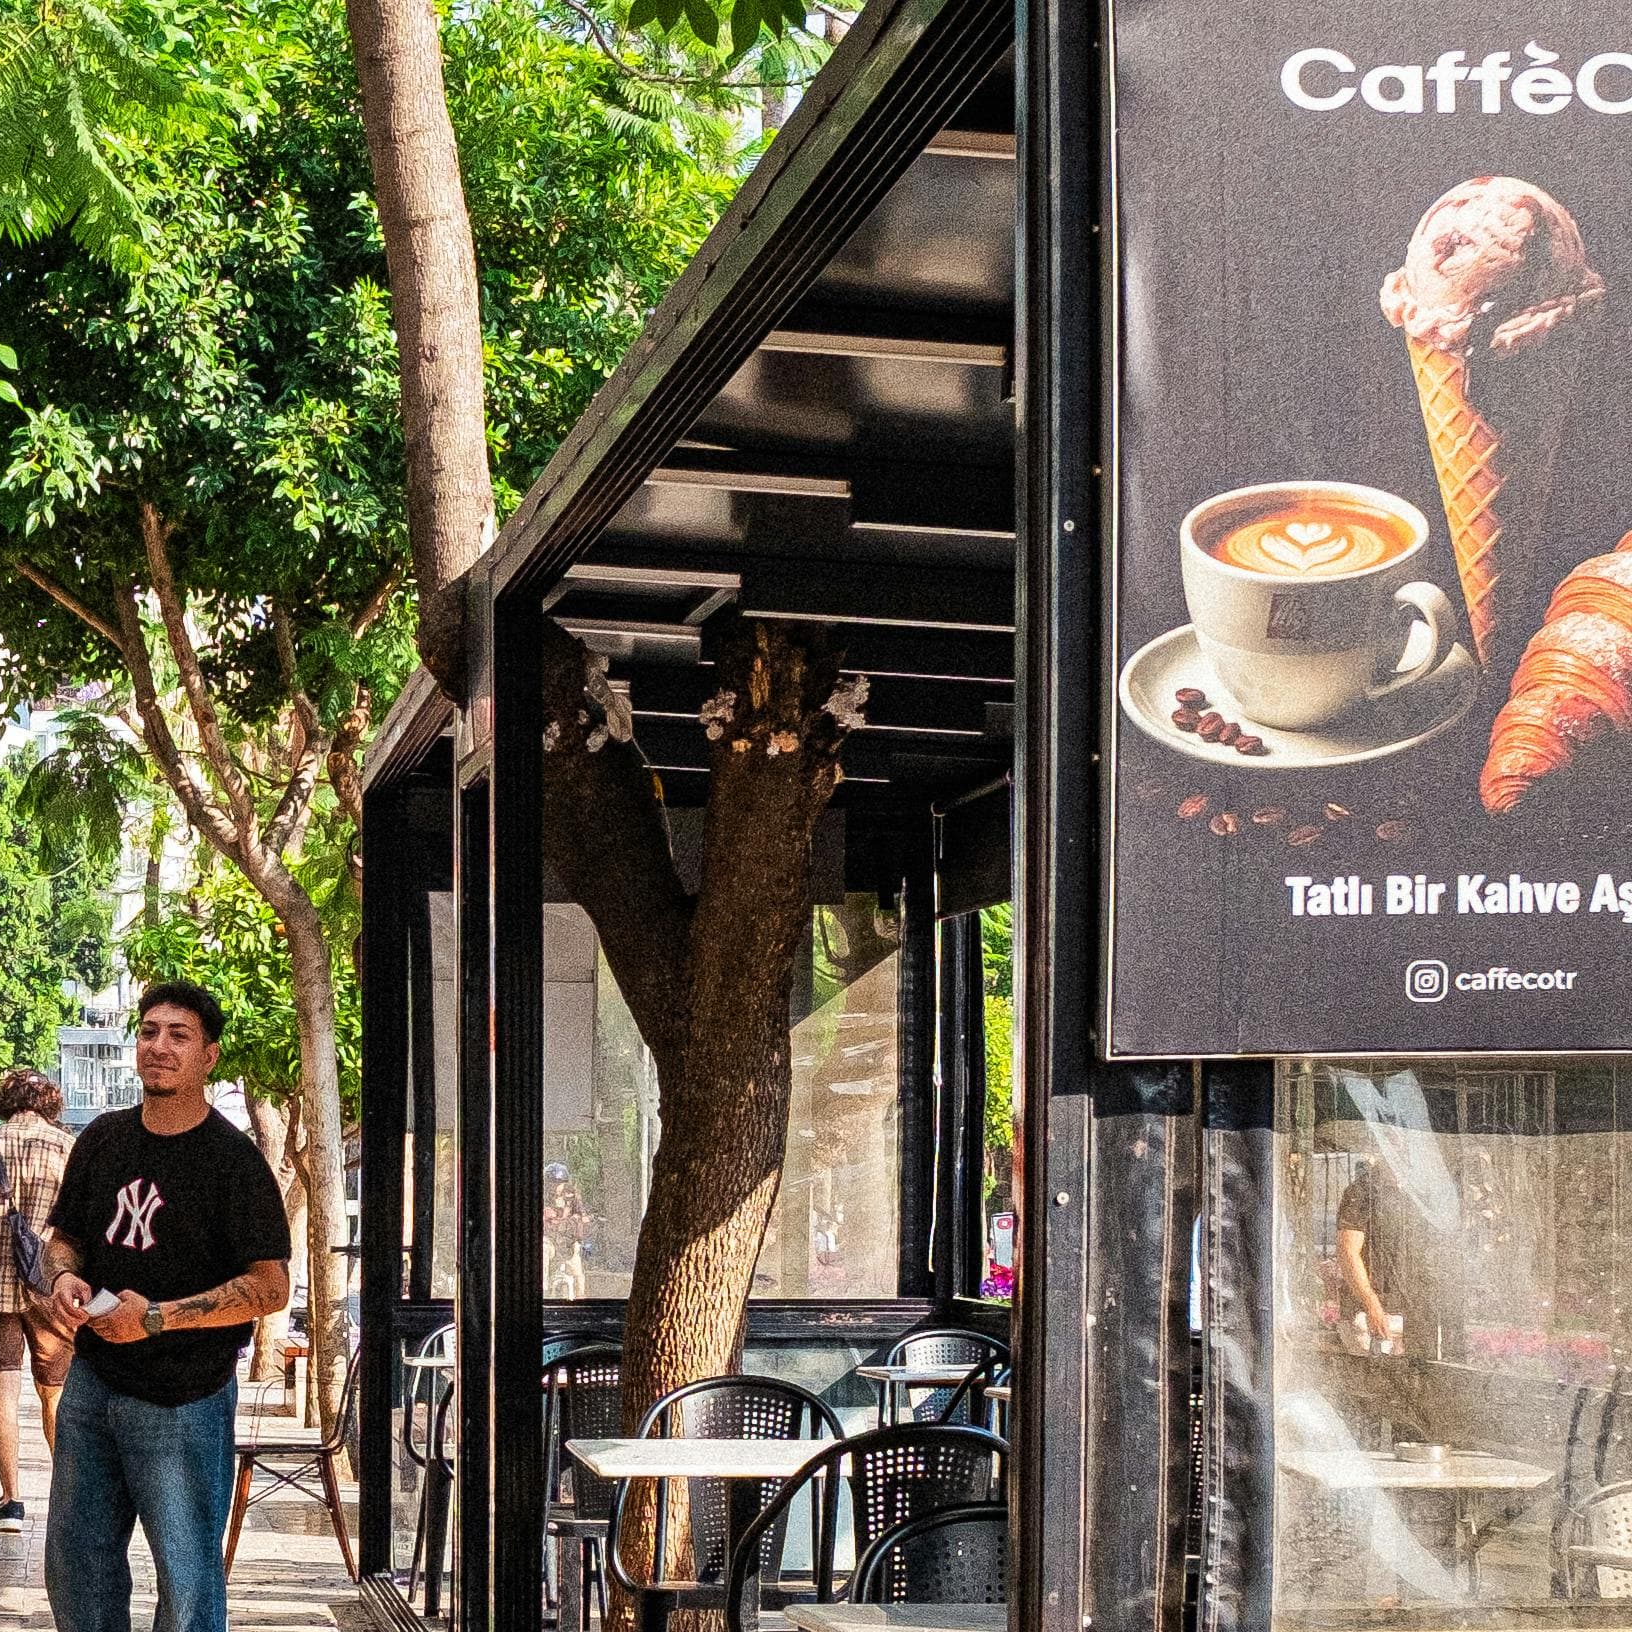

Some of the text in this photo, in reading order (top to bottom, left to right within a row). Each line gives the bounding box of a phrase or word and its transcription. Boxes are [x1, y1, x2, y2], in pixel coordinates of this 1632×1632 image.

[1285, 876, 1373, 917] Tatlı
[1386, 874, 1446, 915] Bir
[1457, 874, 1581, 915] Kahve
[1455, 967, 1578, 991] caffecotr
[105, 1177, 164, 1251] NY
